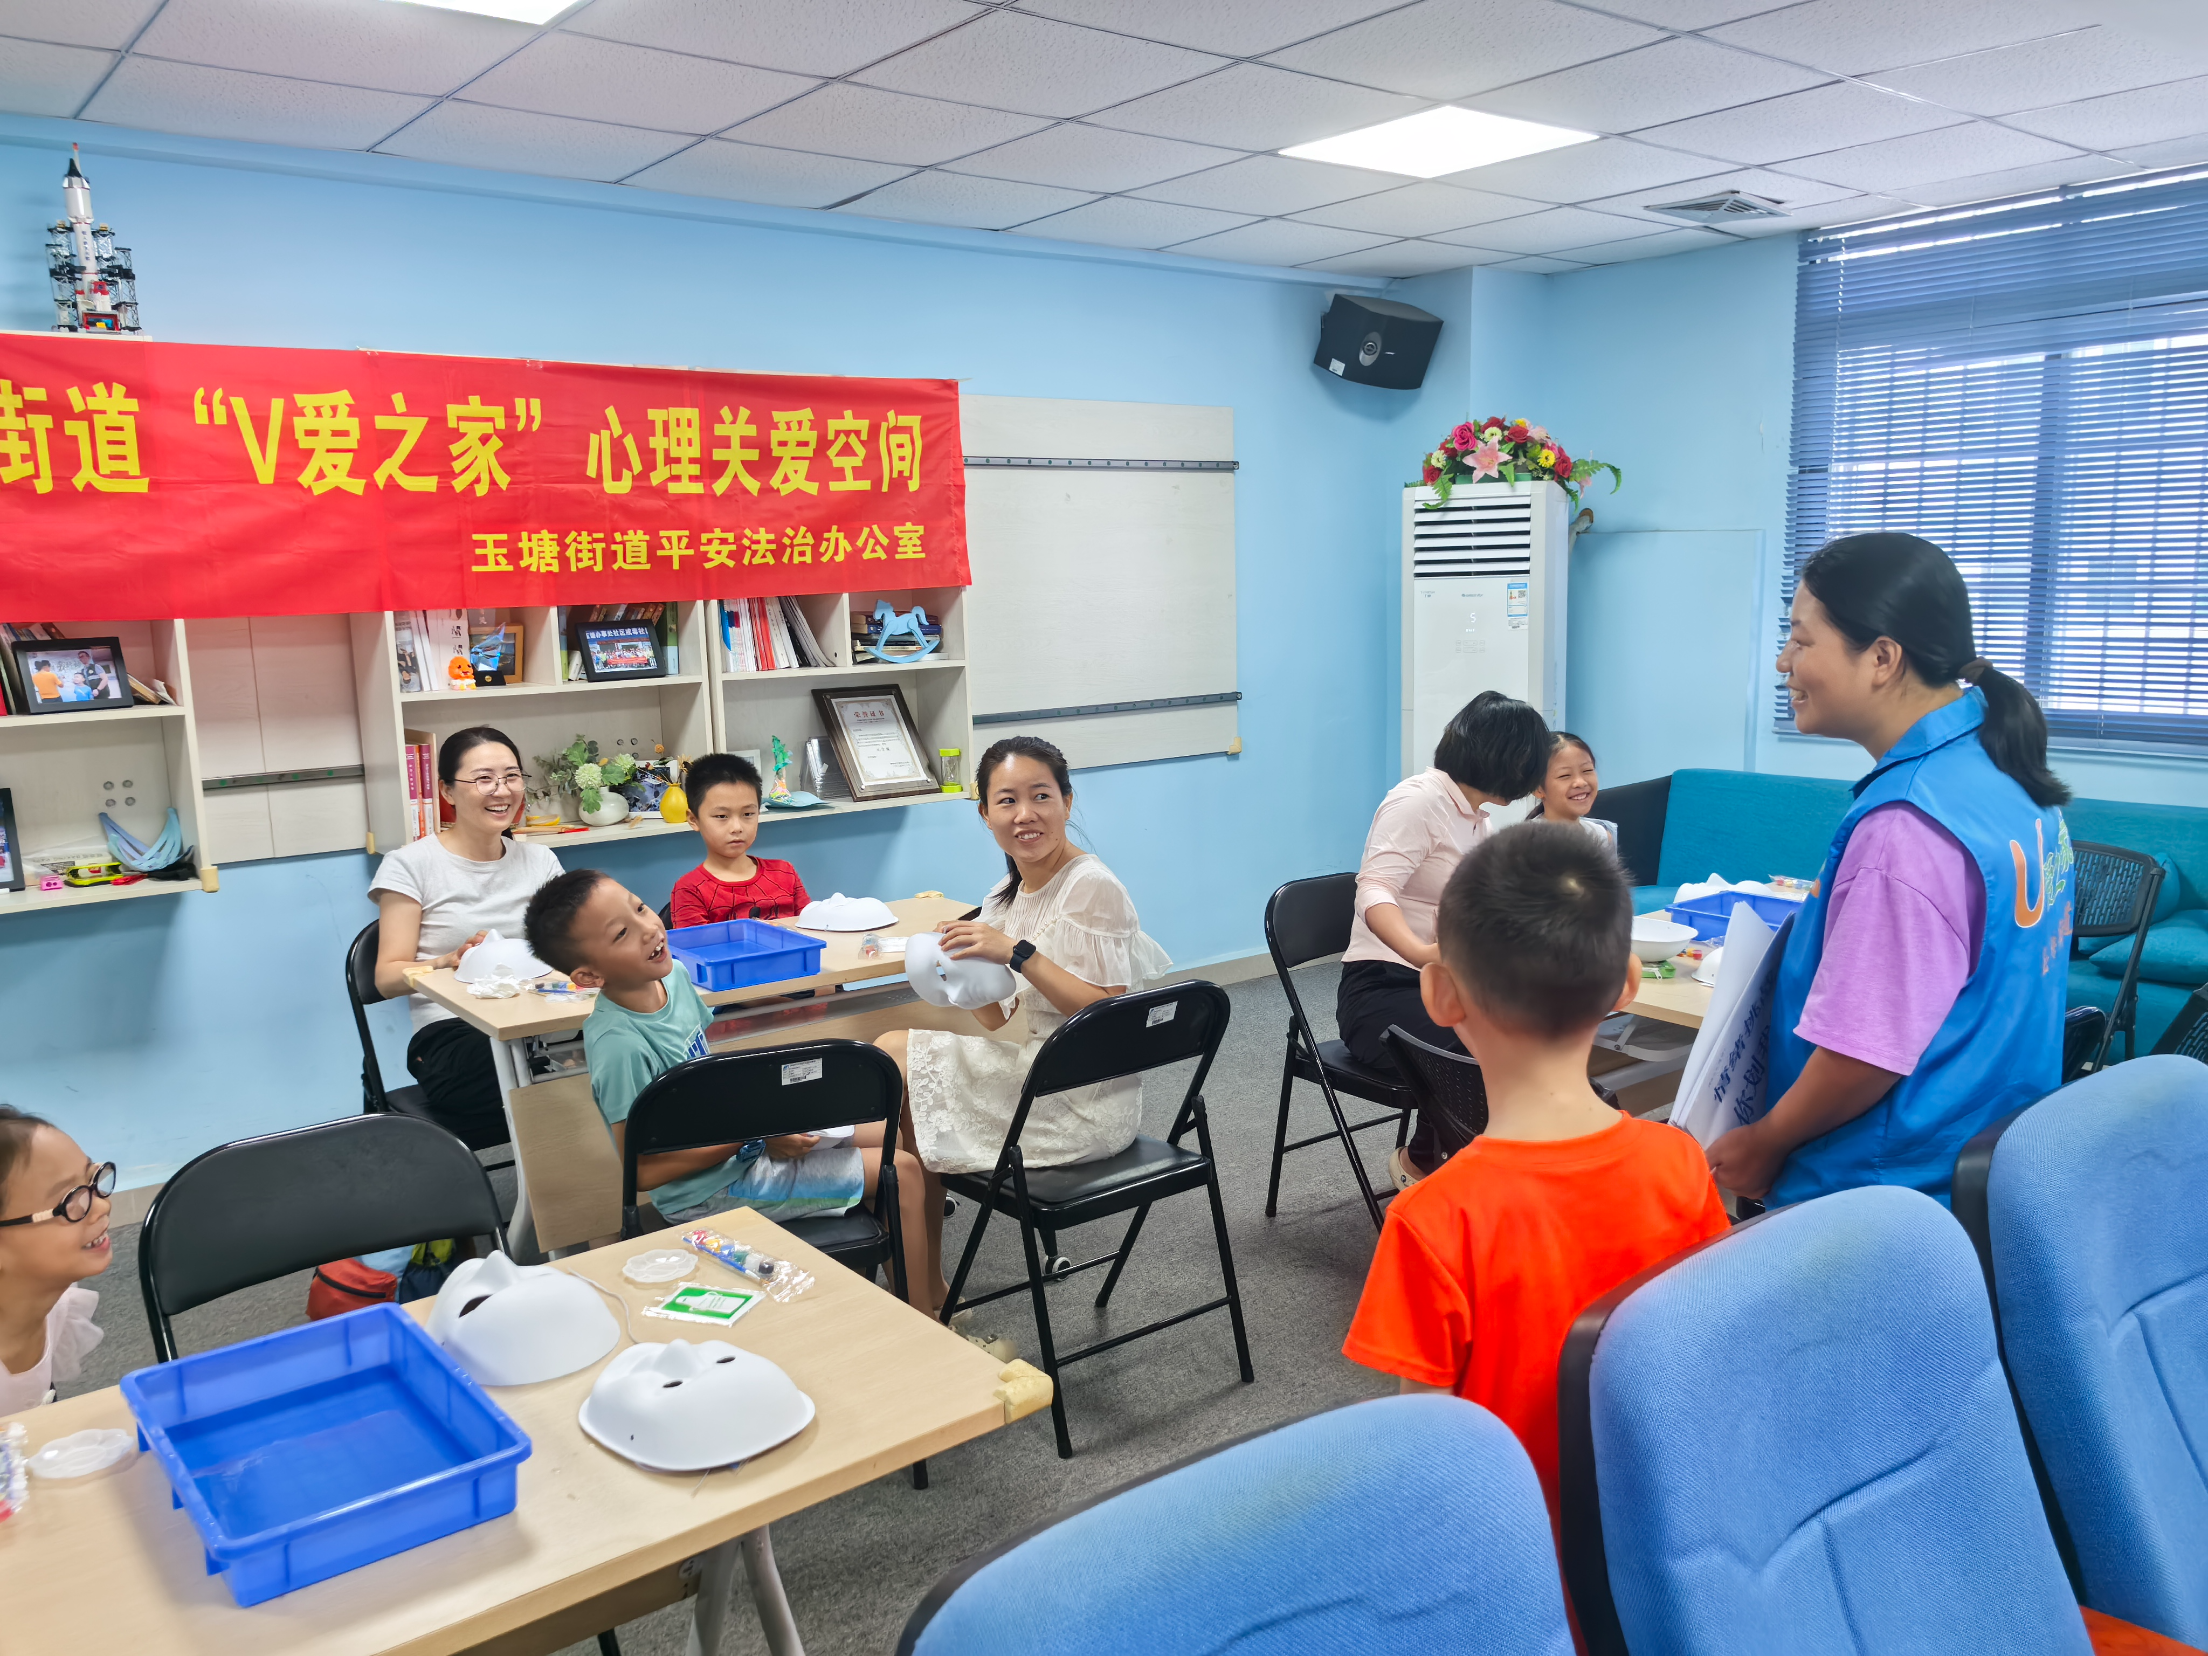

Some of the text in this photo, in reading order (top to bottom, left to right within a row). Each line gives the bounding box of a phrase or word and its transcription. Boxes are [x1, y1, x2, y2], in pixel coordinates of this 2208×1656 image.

[0, 379, 150, 495] 街道
[586, 406, 923, 497] 心理关爱空间
[471, 522, 926, 573] 玉塘街道平安法治办公室
